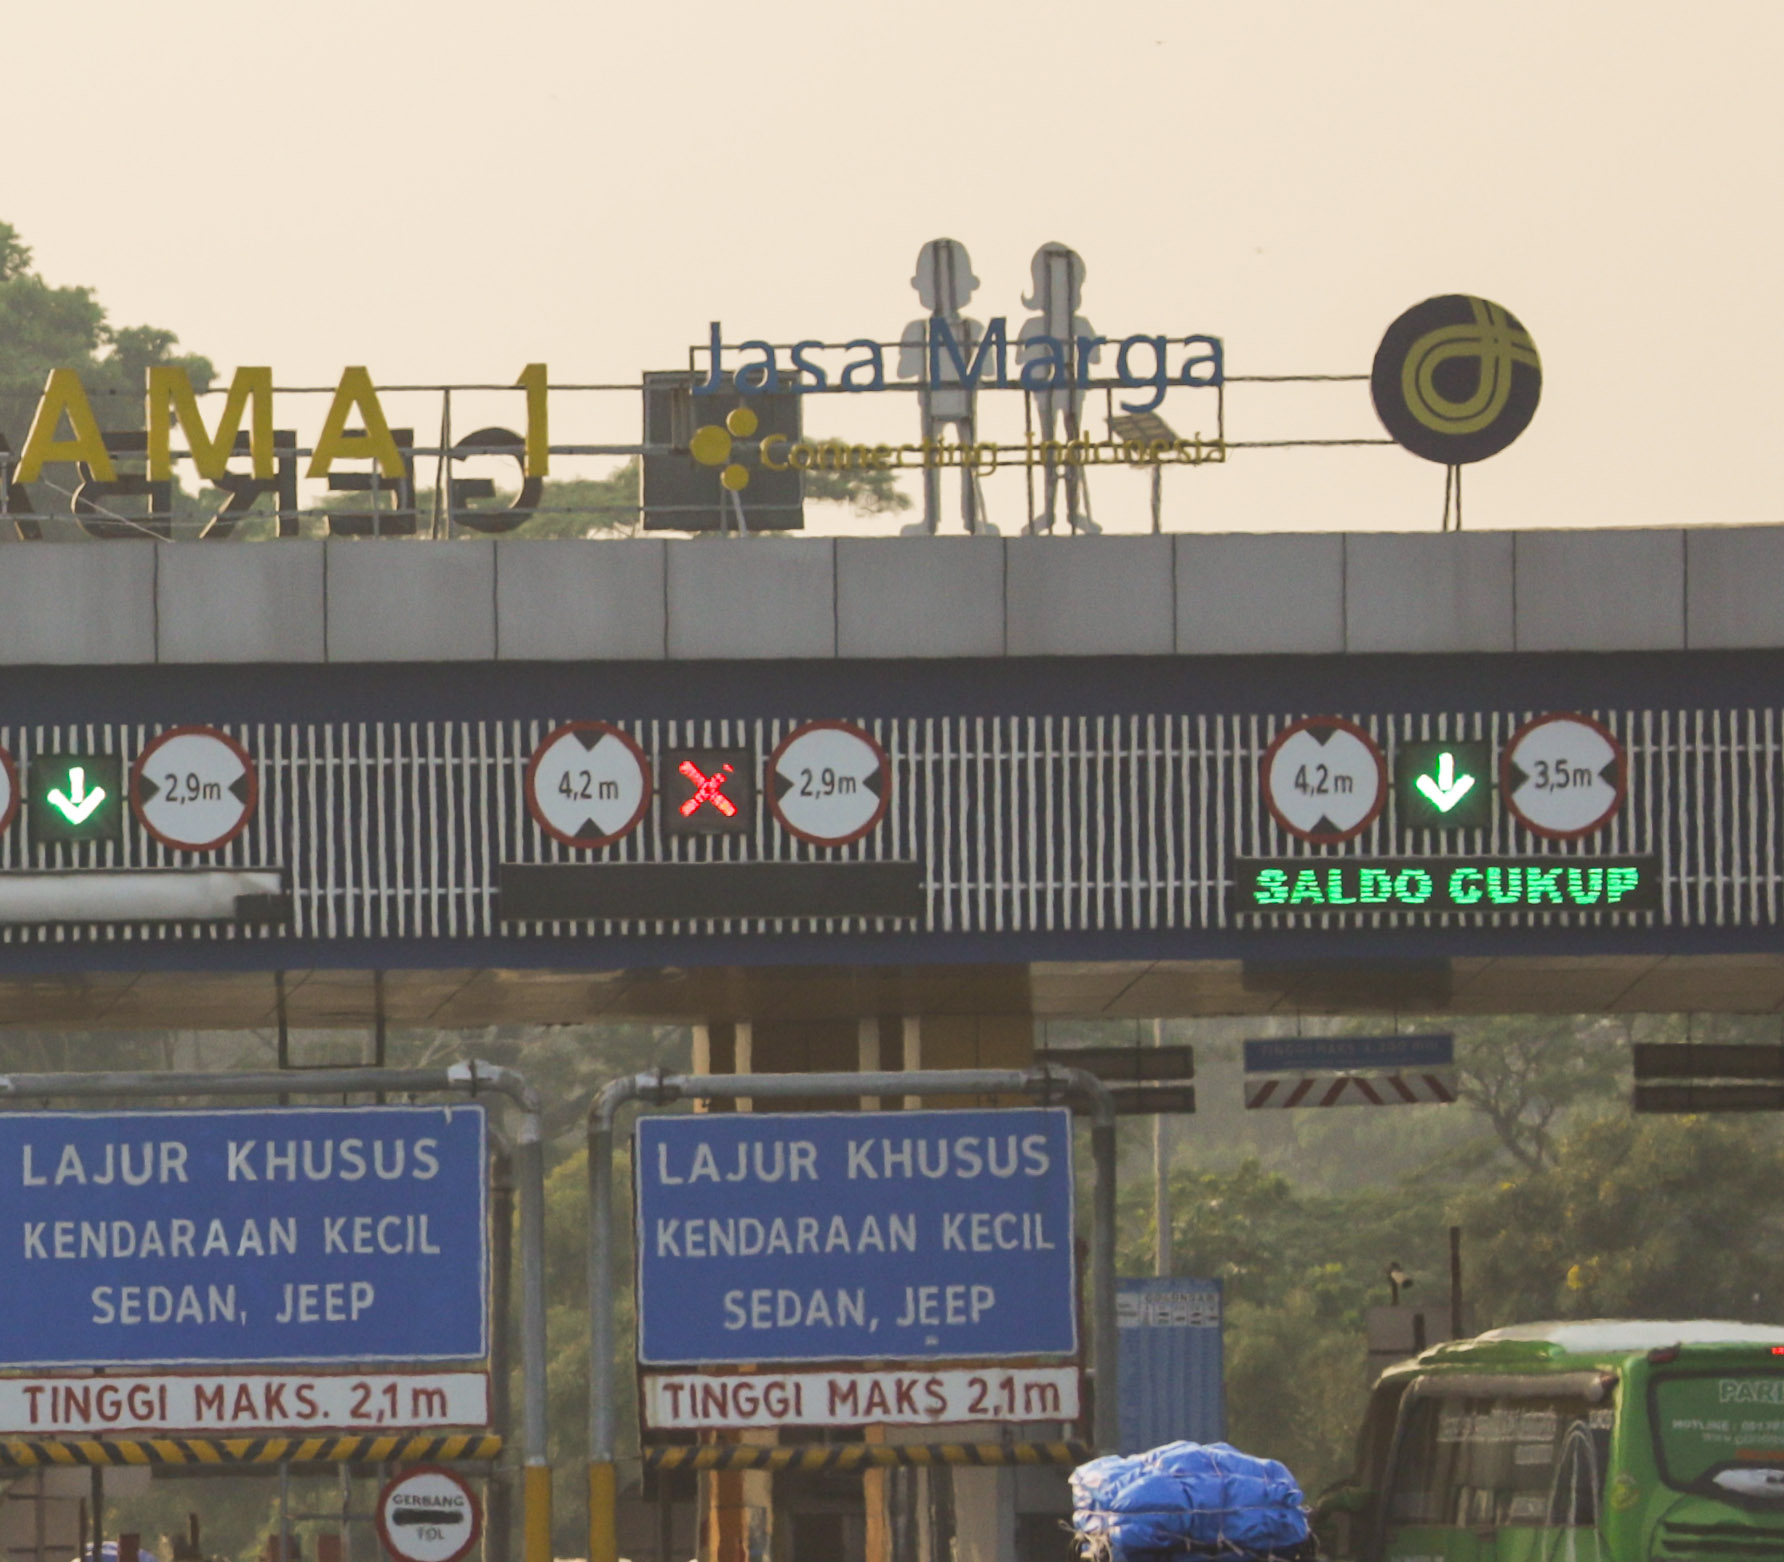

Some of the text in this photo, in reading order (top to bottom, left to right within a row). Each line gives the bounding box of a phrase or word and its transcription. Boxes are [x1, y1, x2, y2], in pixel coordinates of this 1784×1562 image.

[691, 316, 1225, 415] Jasa Marga
[760, 430, 1226, 478] Connecting Indonesia
[557, 770, 593, 804] 4,2
[1293, 763, 1329, 799] 4,2
[22, 1137, 440, 1187] LAJUR KHUSUS
[657, 1134, 1050, 1185] LAJUR KHUSUS
[23, 1214, 441, 1260] KENDARAAN KECIL
[656, 1211, 1055, 1258] KENDARAAN KECIL
[91, 1281, 375, 1327] SEDAN, JEEP
[722, 1284, 996, 1334] SEDAN, JEEP
[22, 1381, 448, 1426] TINGGI MAKS. 2,1 m
[662, 1376, 1062, 1420] TINGGI MAKS 2,1 m
[392, 1493, 465, 1507] GERBANG
